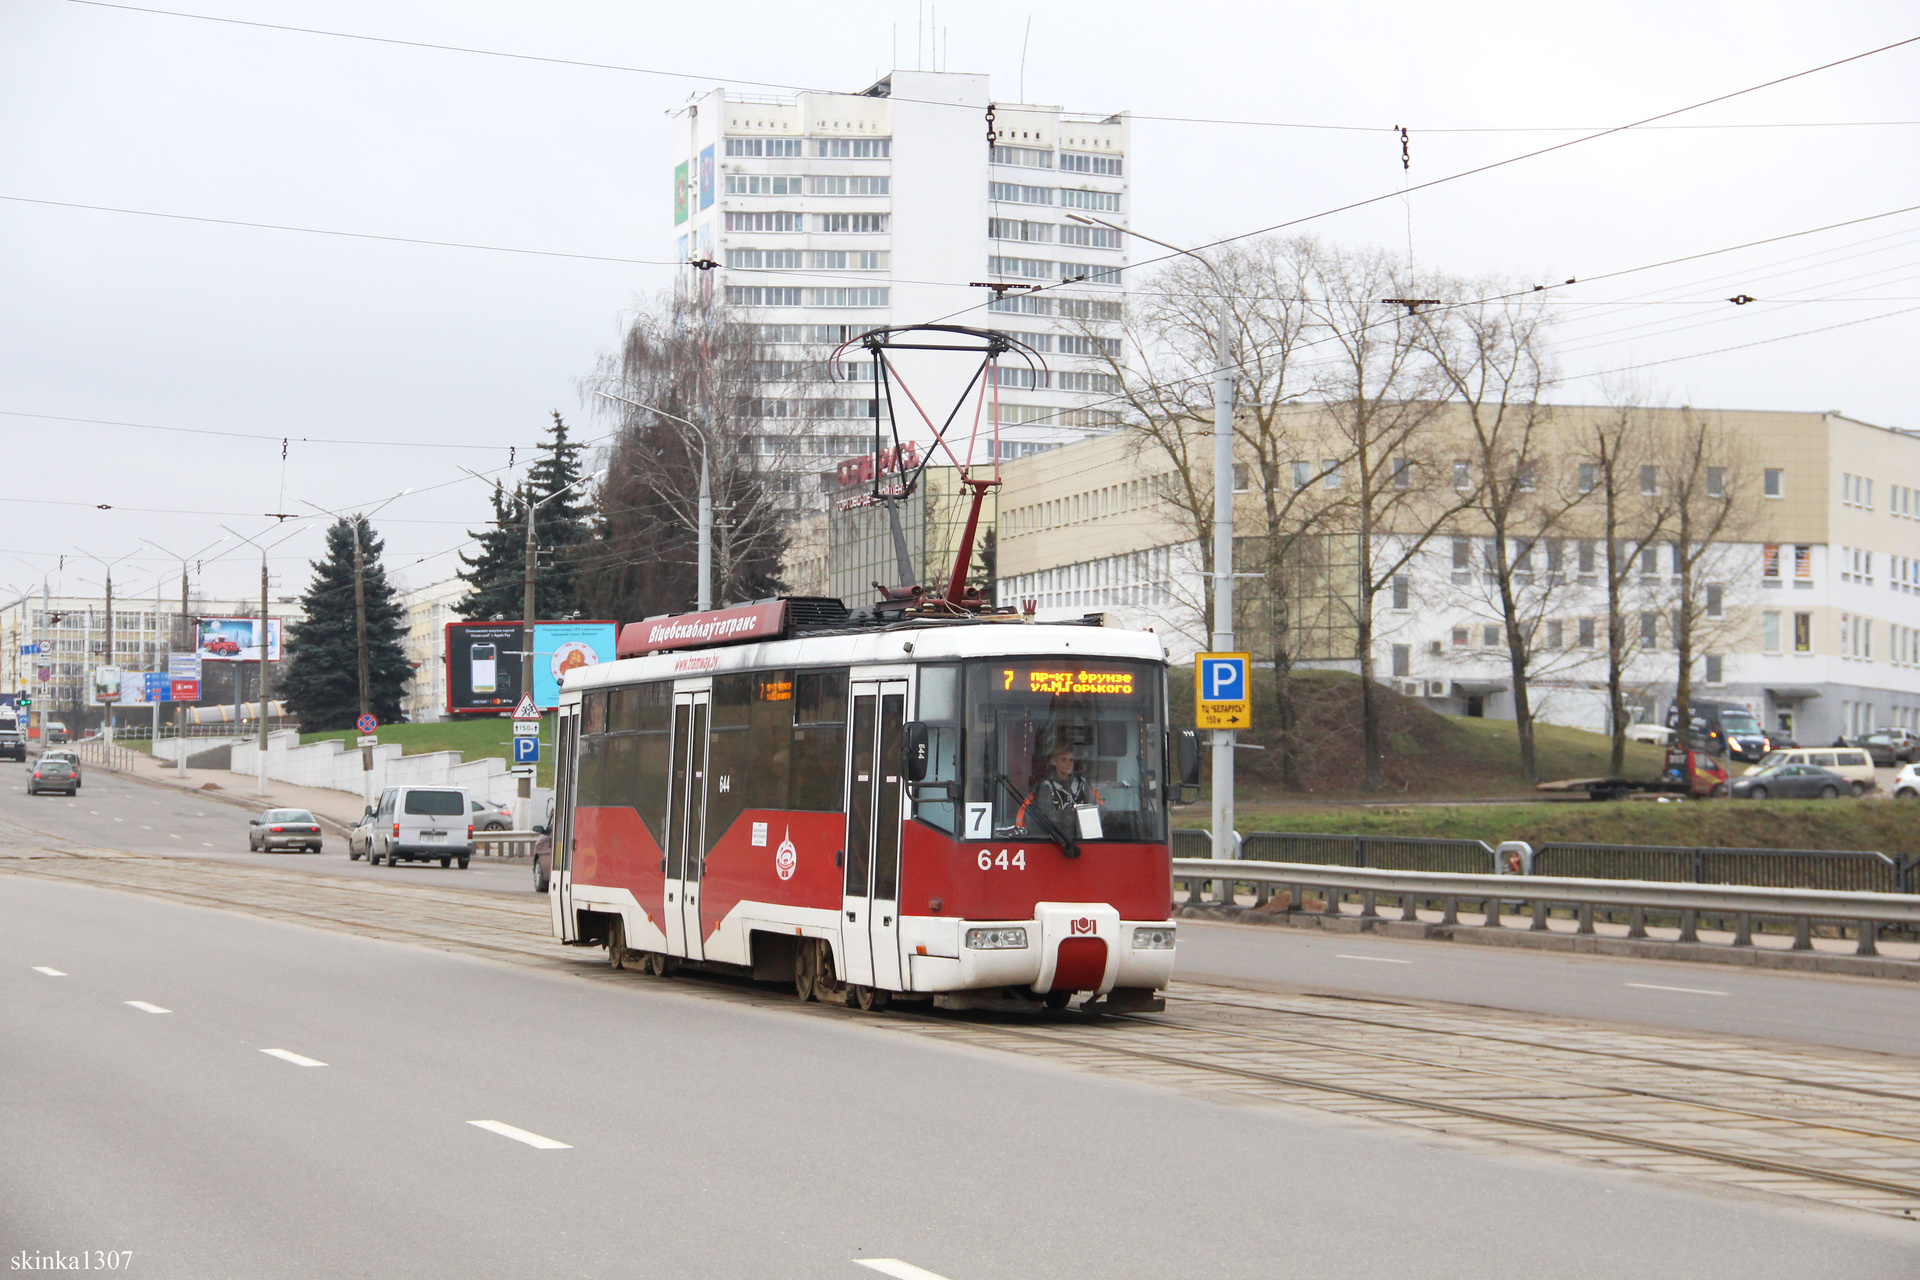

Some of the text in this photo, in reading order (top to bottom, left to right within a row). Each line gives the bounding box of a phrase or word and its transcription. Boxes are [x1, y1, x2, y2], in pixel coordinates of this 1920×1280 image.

[648, 615, 757, 643] Віцебскаблаўтатранс
[1003, 670, 1133, 690] 7 пр-кт Фрунзе
[1213, 663, 1237, 697] P
[1201, 704, 1210, 714] ТЦ
[519, 739, 534, 760] P
[918, 743, 926, 760] 644
[719, 774, 730, 793] 644
[970, 807, 987, 832] 7
[977, 848, 1026, 871] 644
